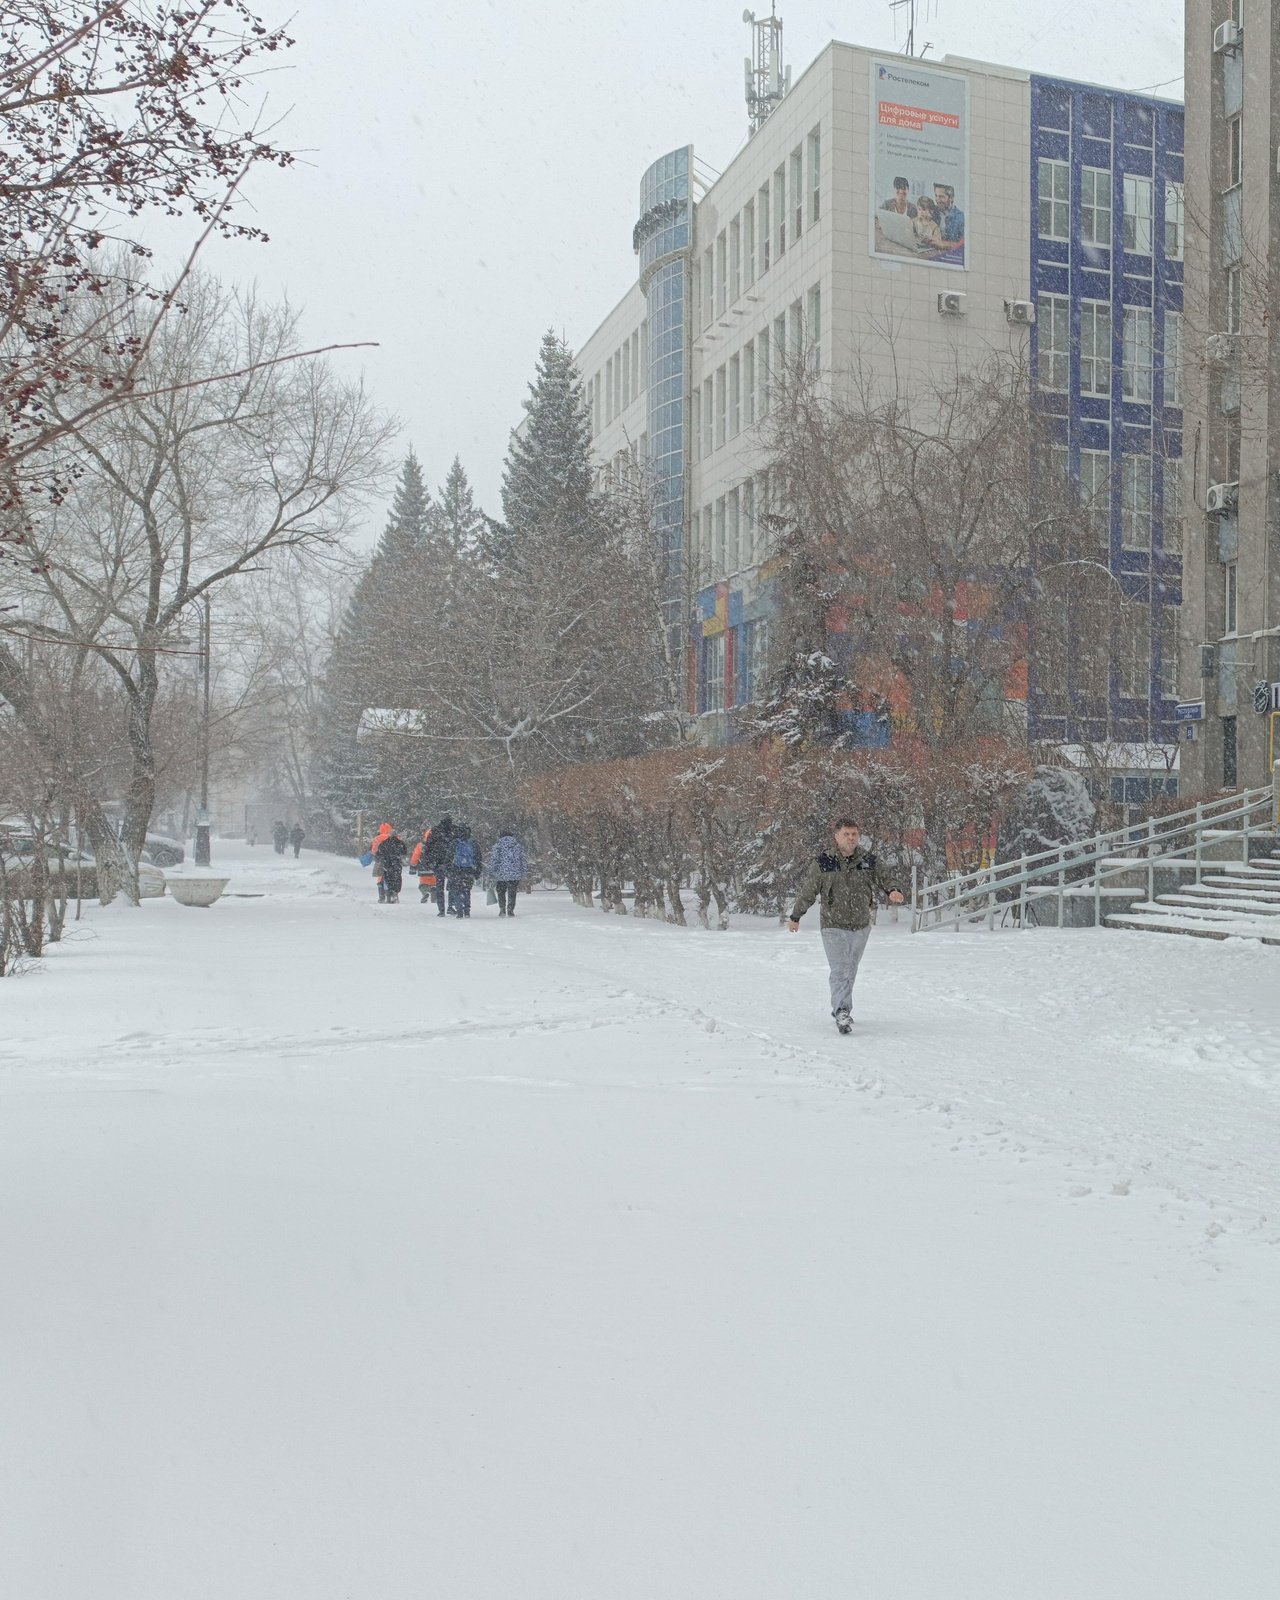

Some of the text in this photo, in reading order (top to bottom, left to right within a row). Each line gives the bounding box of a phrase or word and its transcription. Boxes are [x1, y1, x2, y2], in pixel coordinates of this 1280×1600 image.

[887, 73, 930, 88] Ростелеком
[880, 103, 958, 126] Цифровые услуги
[880, 115, 921, 129] для дома
